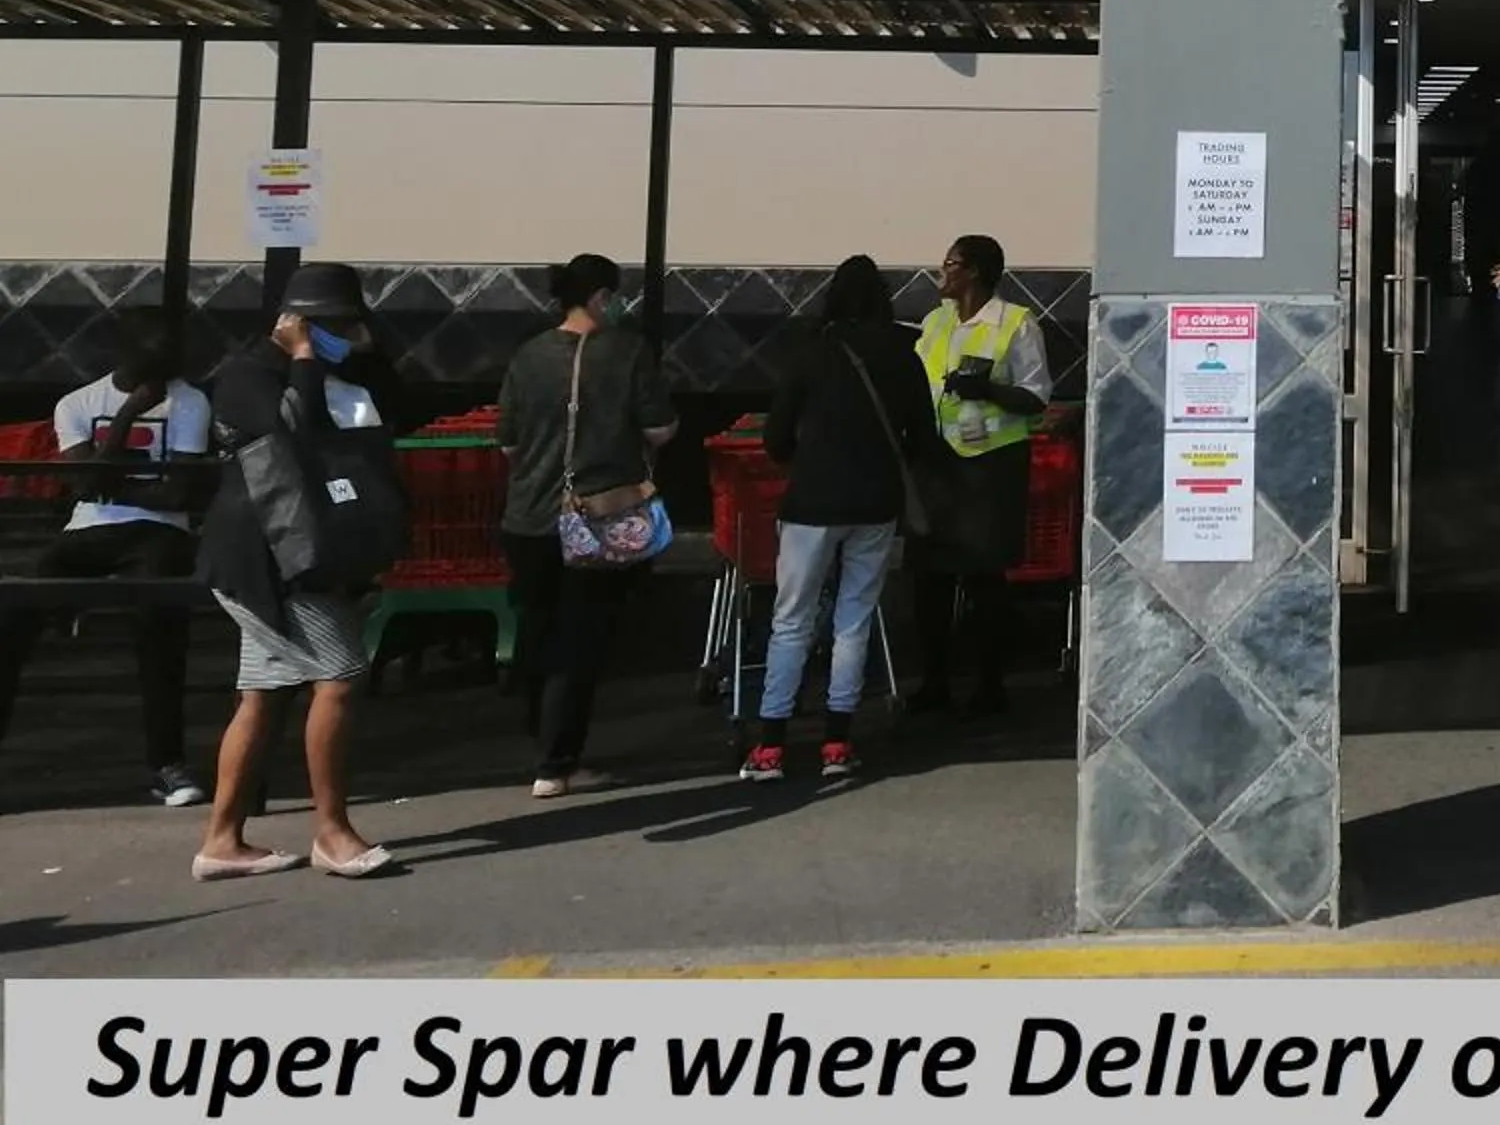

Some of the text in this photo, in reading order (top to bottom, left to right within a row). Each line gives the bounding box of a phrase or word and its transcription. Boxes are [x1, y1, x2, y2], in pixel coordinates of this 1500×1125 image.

[1198, 142, 1246, 153] TRADING
[1202, 154, 1240, 165] HOURS
[1187, 178, 1237, 189] MONDAY
[1193, 190, 1249, 200] SATURDAY
[1197, 215, 1243, 224] SUNDAY
[1191, 314, 1249, 326] COVID-19
